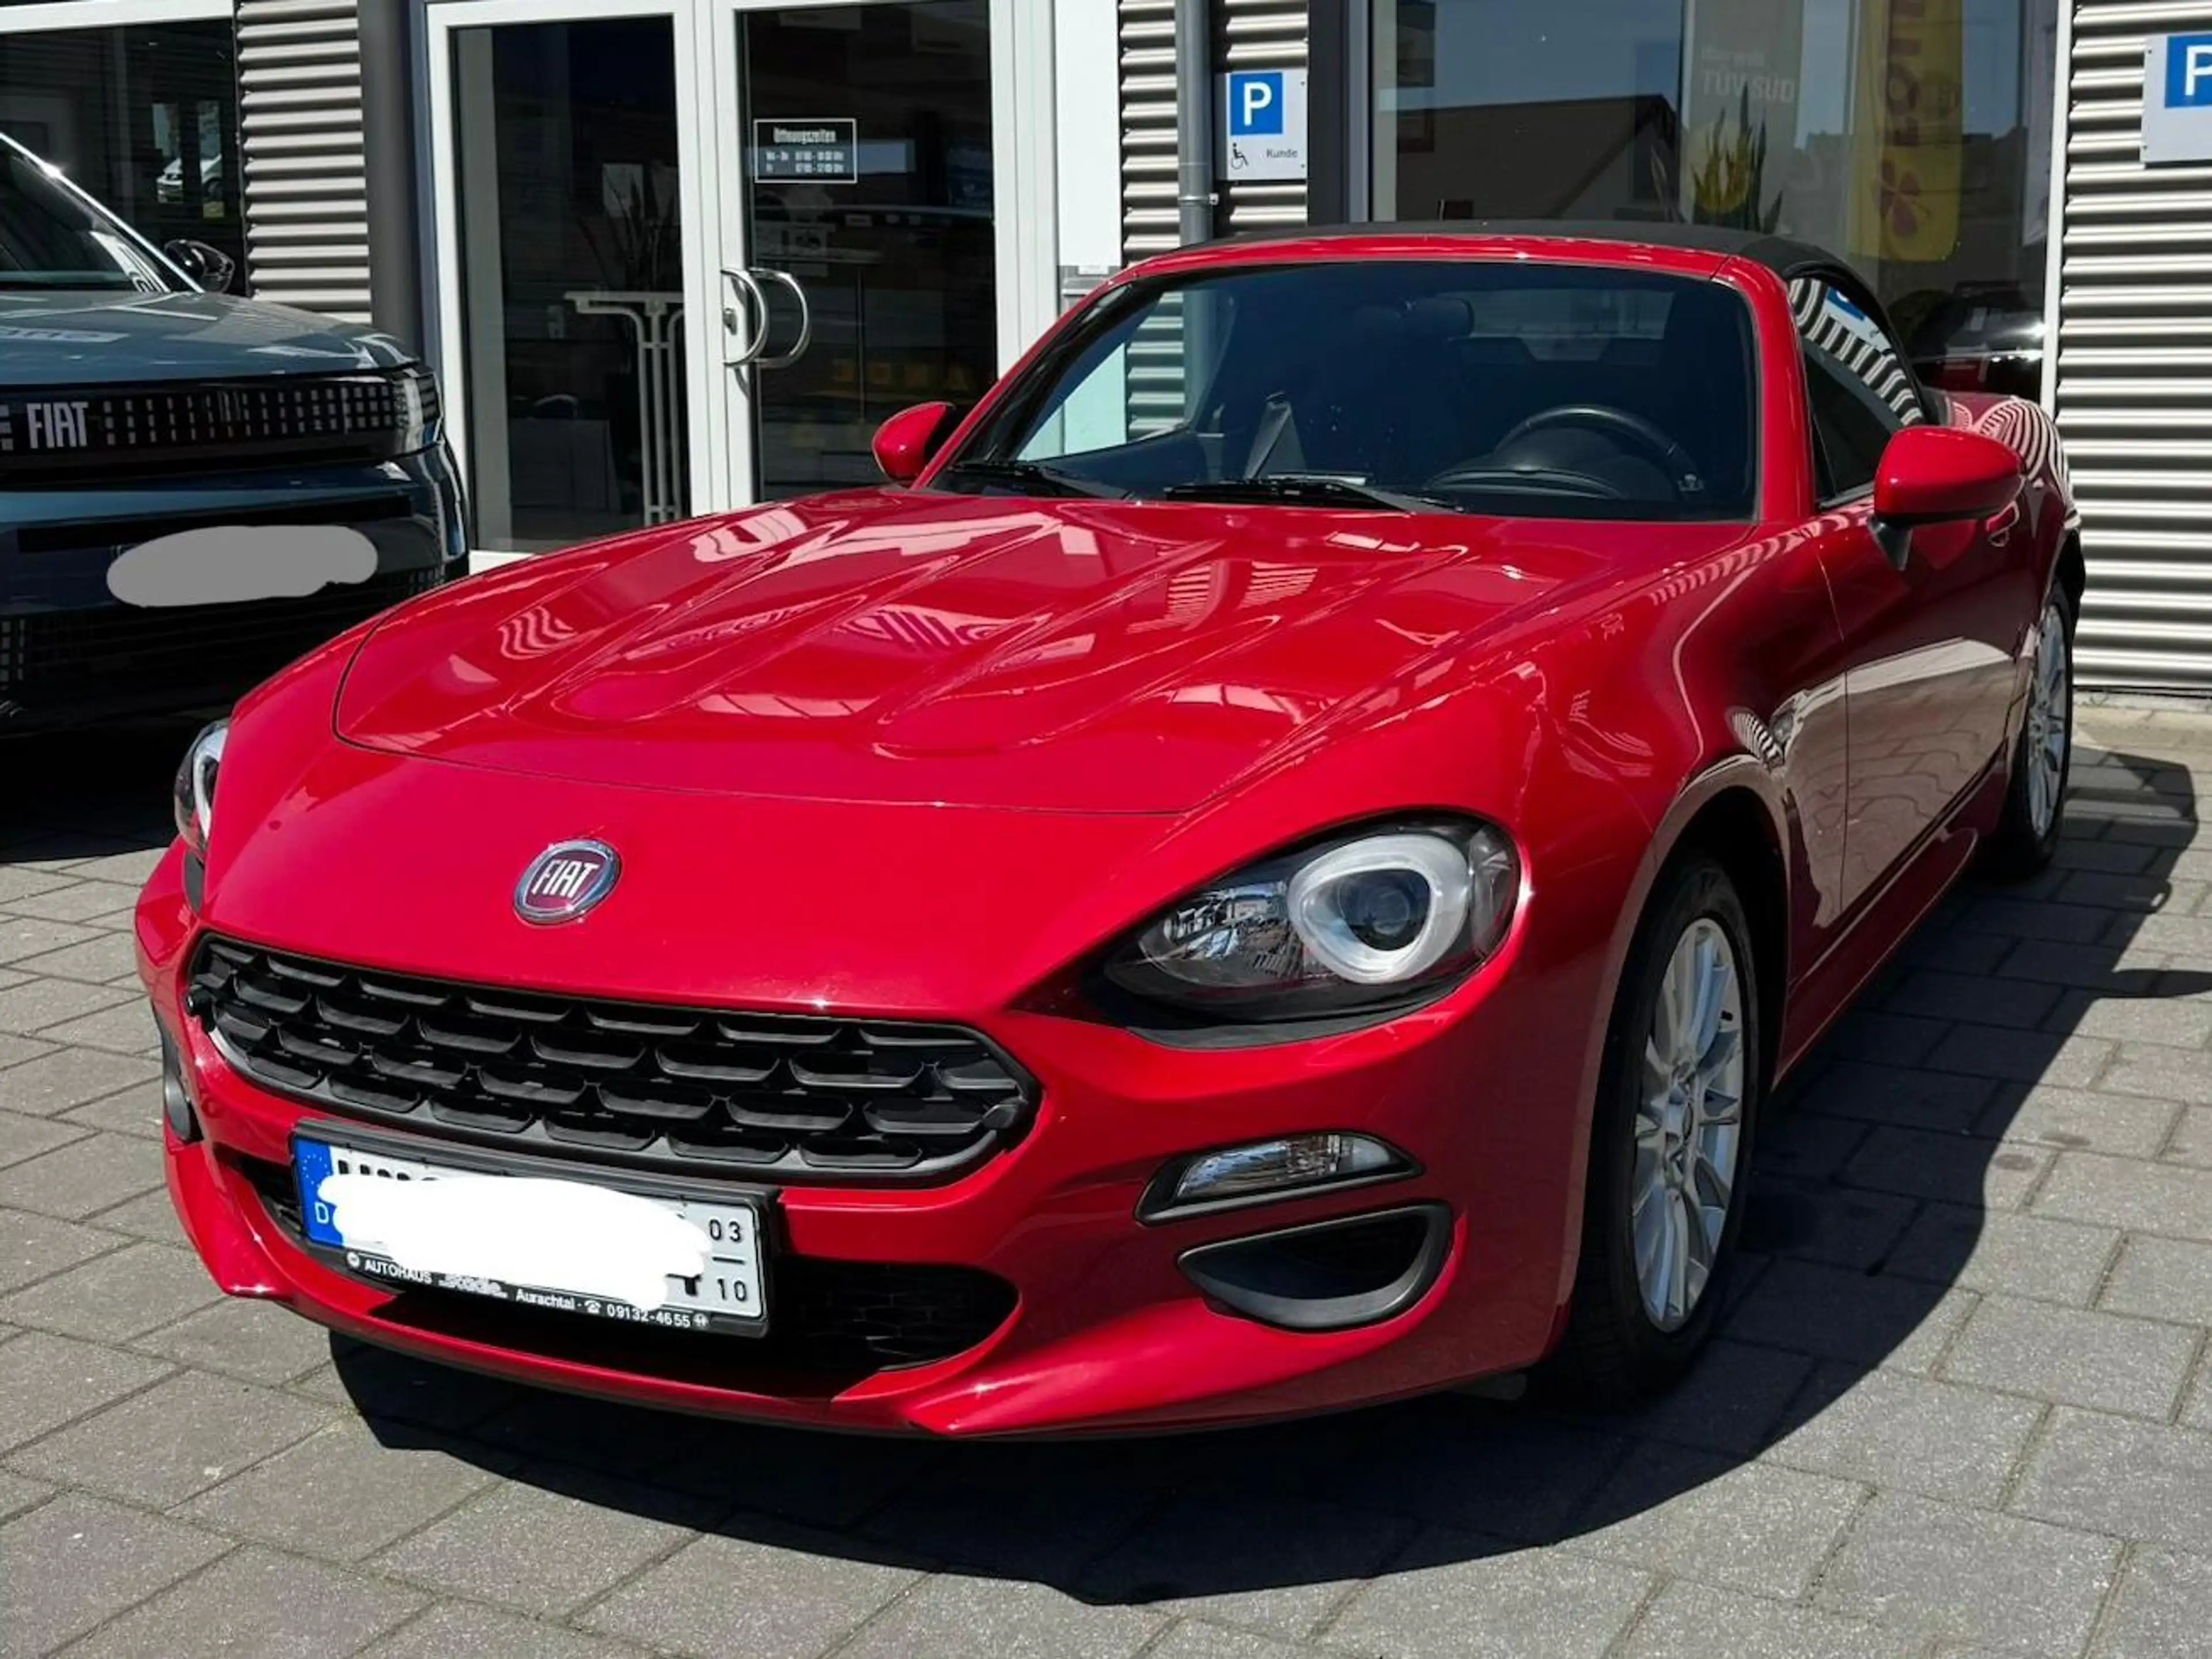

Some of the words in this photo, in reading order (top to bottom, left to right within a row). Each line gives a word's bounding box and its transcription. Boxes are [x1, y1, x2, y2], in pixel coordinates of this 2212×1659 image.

[1243, 81, 1272, 126] P
[1266, 148, 1298, 158] Kunde
[27, 401, 89, 449] FIAT
[531, 859, 600, 899] FIAT
[315, 1200, 329, 1224] D
[709, 1218, 741, 1243] 03
[364, 1259, 432, 1285] AUTOHAUS
[516, 1288, 575, 1310] Aurachtal
[717, 1278, 747, 1302] 10
